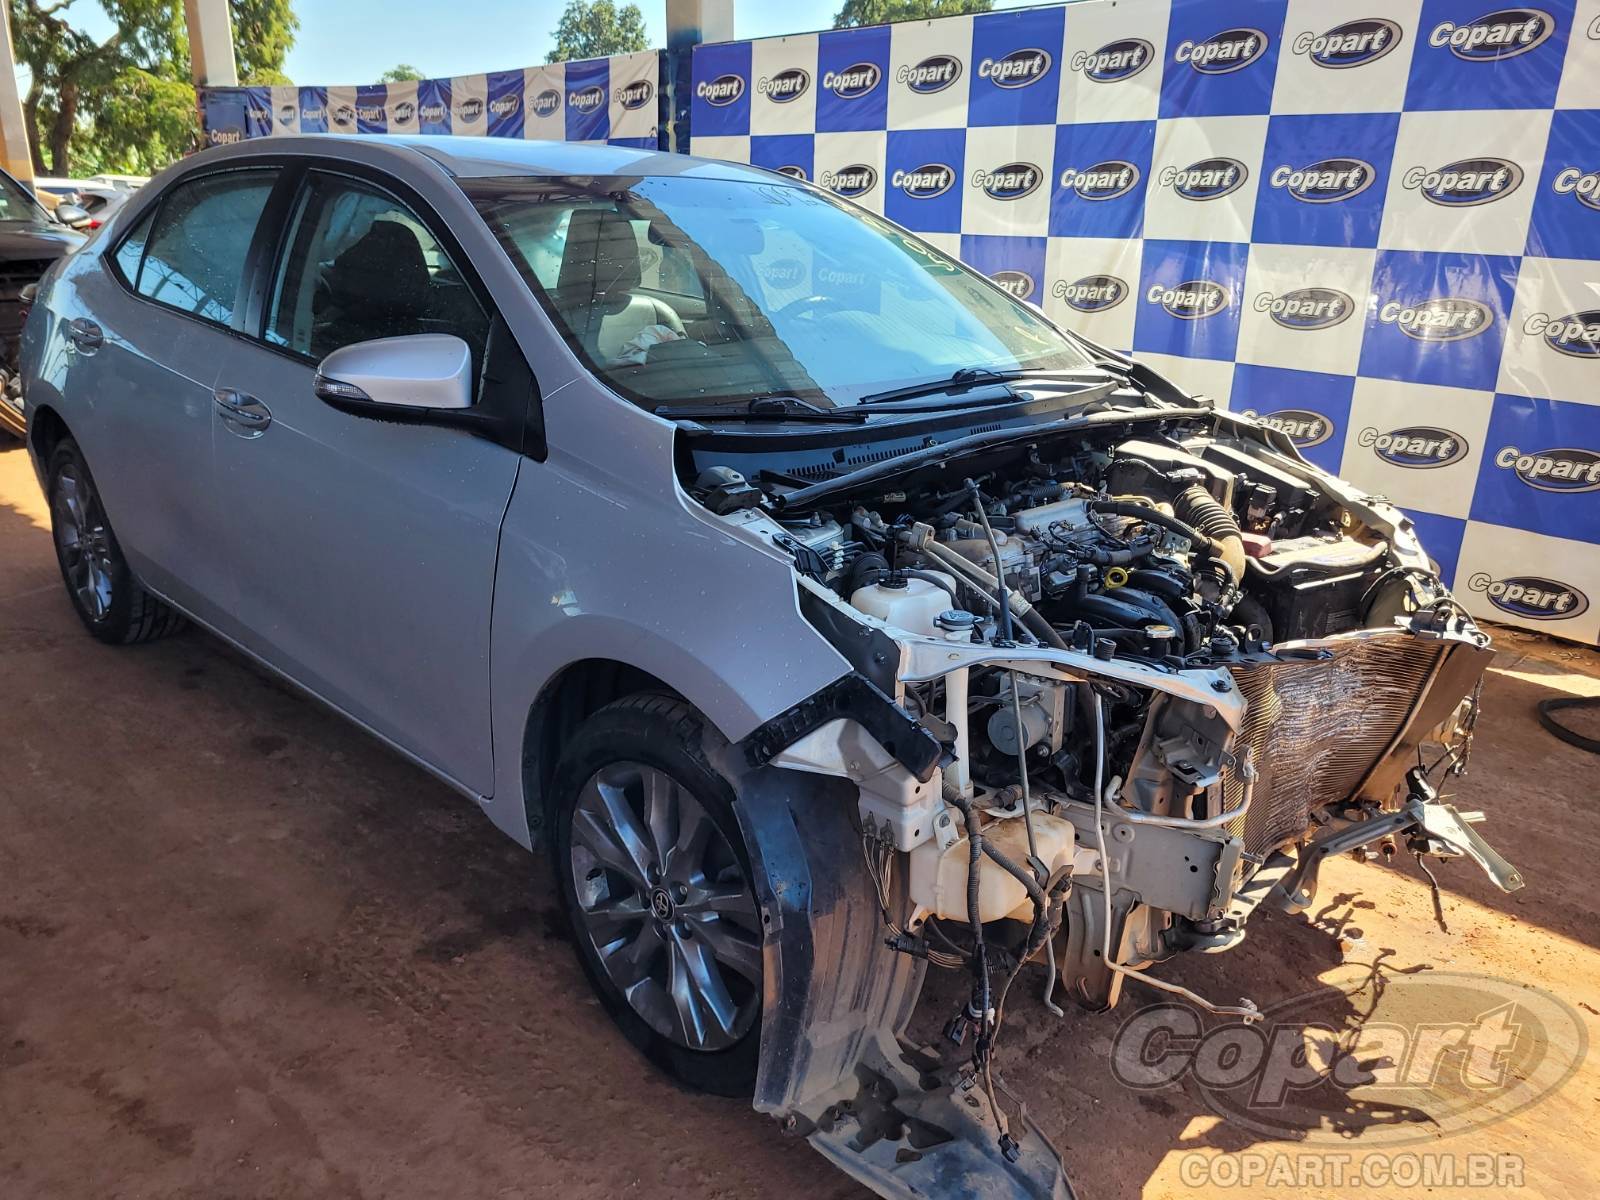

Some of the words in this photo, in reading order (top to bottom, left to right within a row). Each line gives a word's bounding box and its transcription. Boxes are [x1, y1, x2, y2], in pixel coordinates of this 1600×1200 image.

[1293, 25, 1391, 60] Copart
[1428, 14, 1542, 51] Copart
[1070, 44, 1145, 75] Copart
[1174, 34, 1259, 67] Copart
[823, 67, 876, 92] Copart
[896, 61, 954, 87] Copart
[978, 53, 1044, 82] Copart
[568, 91, 601, 108] Copart
[697, 80, 741, 101] Copart
[757, 75, 804, 98] Copart
[528, 95, 557, 112] Copart
[211, 128, 241, 145] Copart
[821, 170, 870, 192] Copart
[891, 166, 949, 192] Copart
[971, 166, 1036, 193] Copart
[1060, 164, 1133, 191] Copart
[1159, 163, 1236, 192] Copart
[1269, 163, 1365, 194] Copart
[1402, 164, 1509, 196] Copart
[1052, 279, 1119, 304] Copart
[1146, 284, 1220, 312] Copart
[1253, 290, 1343, 324] Copart
[1379, 302, 1478, 336] Copart
[1523, 312, 1600, 345] Copa
[1358, 427, 1455, 463] Copart
[1496, 446, 1600, 483] Copart
[1467, 572, 1575, 614] Copart
